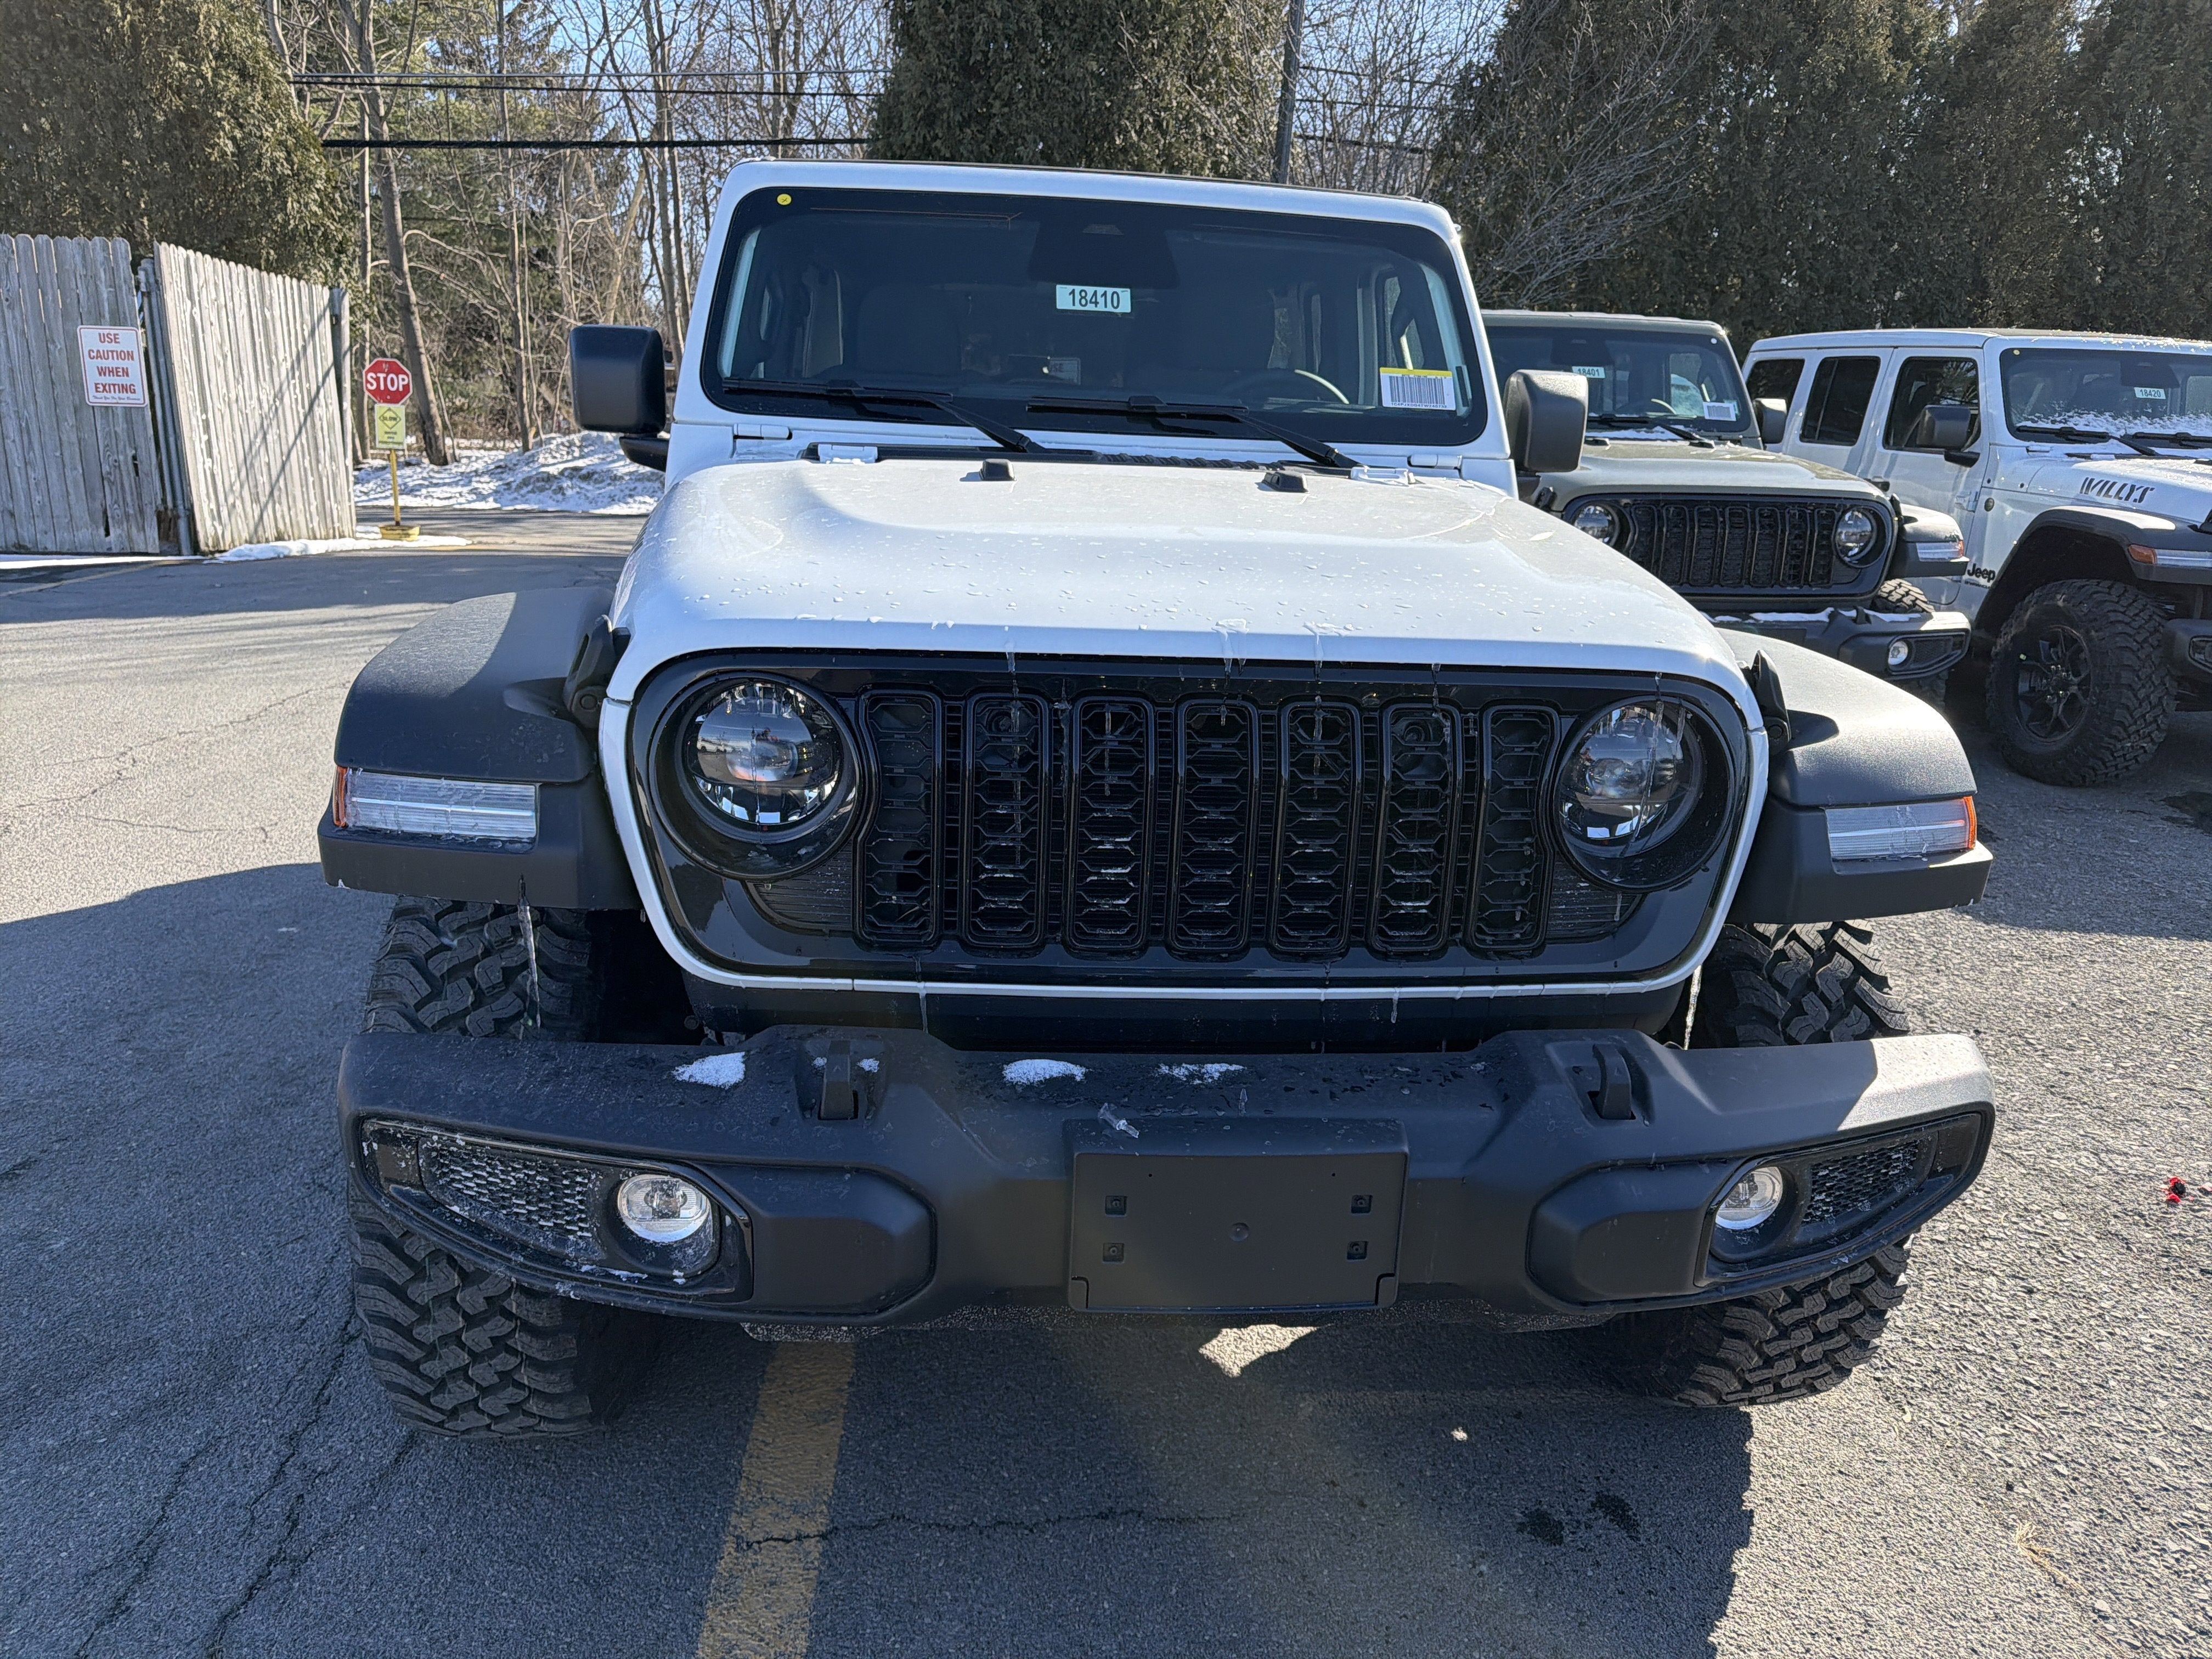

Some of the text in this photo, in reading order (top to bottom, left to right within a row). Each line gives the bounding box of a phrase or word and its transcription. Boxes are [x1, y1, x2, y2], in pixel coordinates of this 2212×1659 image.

[1068, 288, 1120, 309] 18410
[99, 332, 120, 344] USE
[88, 349, 134, 361] CAUTION
[97, 366, 129, 377] WHEN
[1578, 368, 1600, 377] 18401
[94, 382, 136, 394] EXITING
[366, 373, 408, 391] STOP
[2140, 389, 2161, 398] 18420
[2079, 477, 2155, 503] WILLYS
[1967, 563, 1995, 583] Jeep
